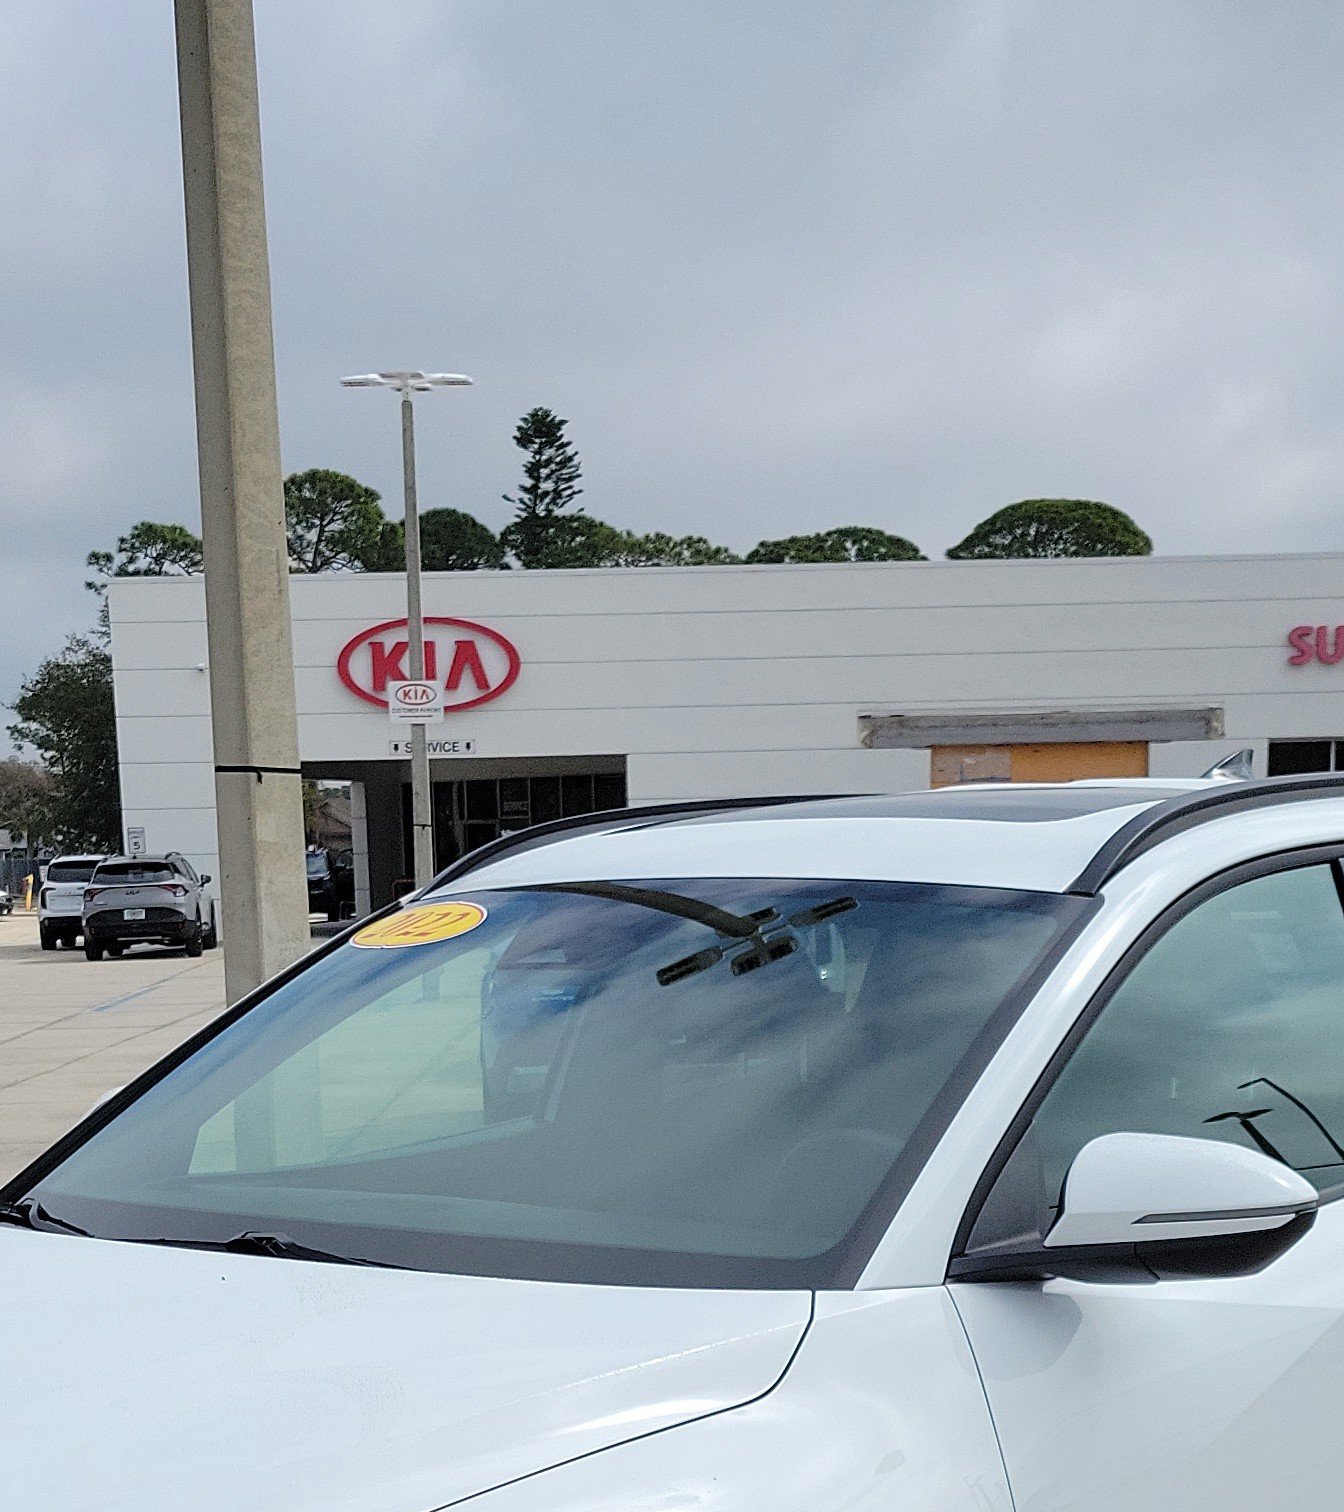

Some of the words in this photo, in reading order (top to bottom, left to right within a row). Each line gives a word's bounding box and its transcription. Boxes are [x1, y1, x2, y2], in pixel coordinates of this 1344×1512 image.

[368, 640, 491, 693] KIA
[402, 686, 430, 701] KIA
[404, 741, 461, 754] SVICE
[360, 911, 471, 938] 2022
